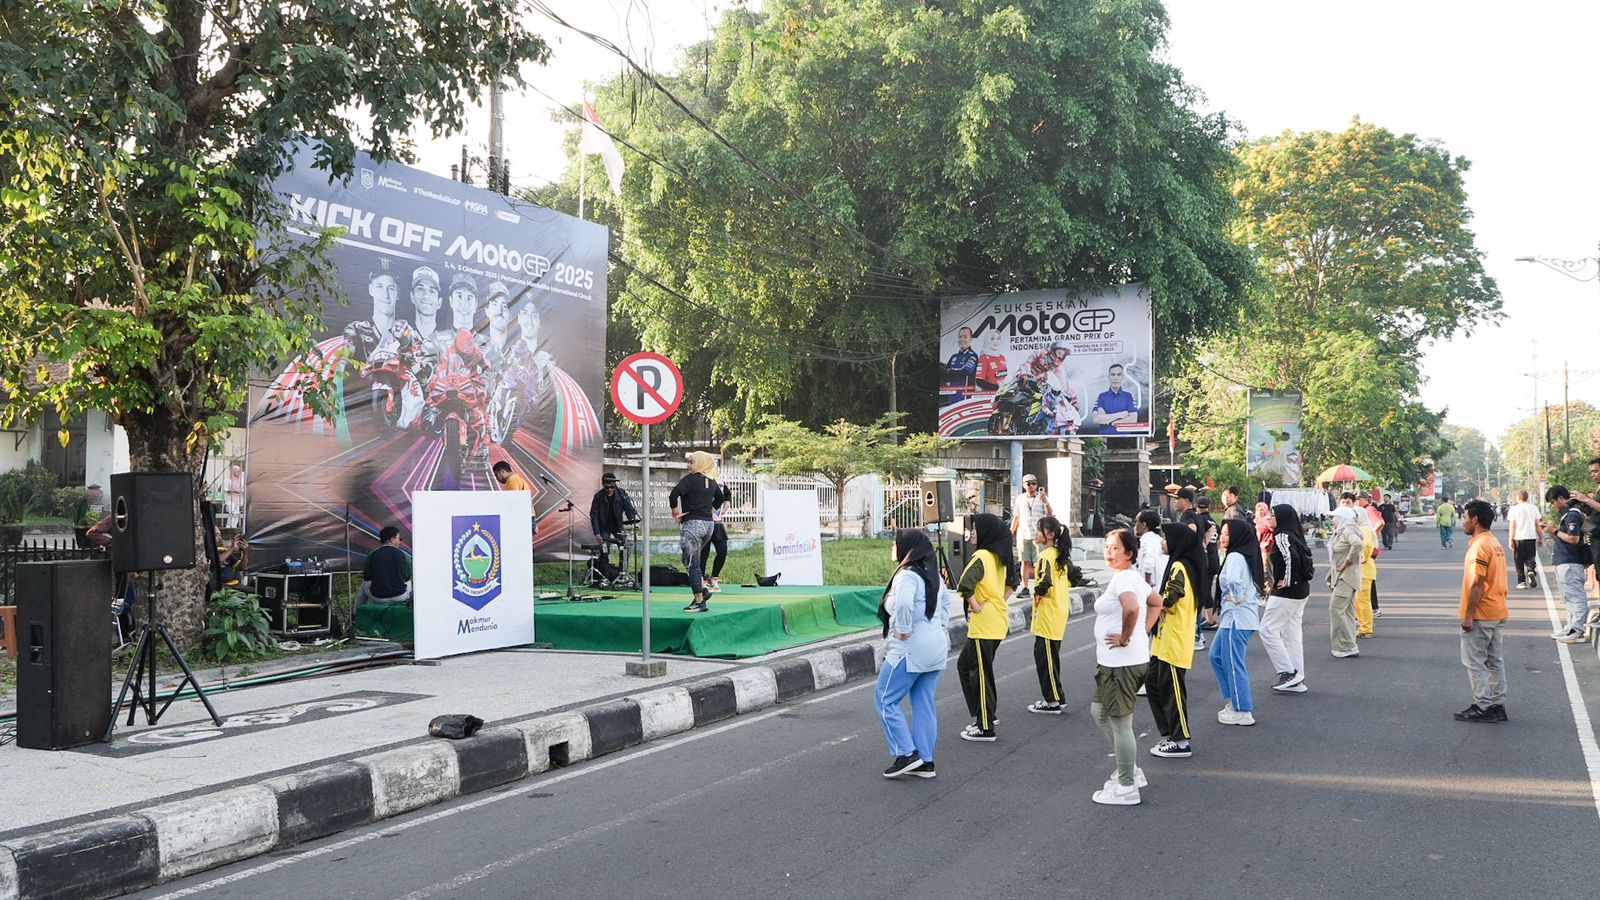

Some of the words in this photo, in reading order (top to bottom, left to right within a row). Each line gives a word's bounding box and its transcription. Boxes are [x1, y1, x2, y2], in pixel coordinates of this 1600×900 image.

[289, 193, 376, 239] KICK
[379, 216, 444, 253] OFF
[445, 235, 551, 278] MotoGP
[554, 262, 594, 290] 2025
[551, 286, 578, 298] International
[994, 299, 1089, 313] SUKSESKAN
[972, 308, 1116, 338] MotoGP
[1010, 335, 1052, 344] PERTAMINA
[1054, 333, 1081, 342] GRAND
[1083, 332, 1102, 340] PRIX
[1104, 331, 1115, 339] OF
[636, 365, 662, 410] P
